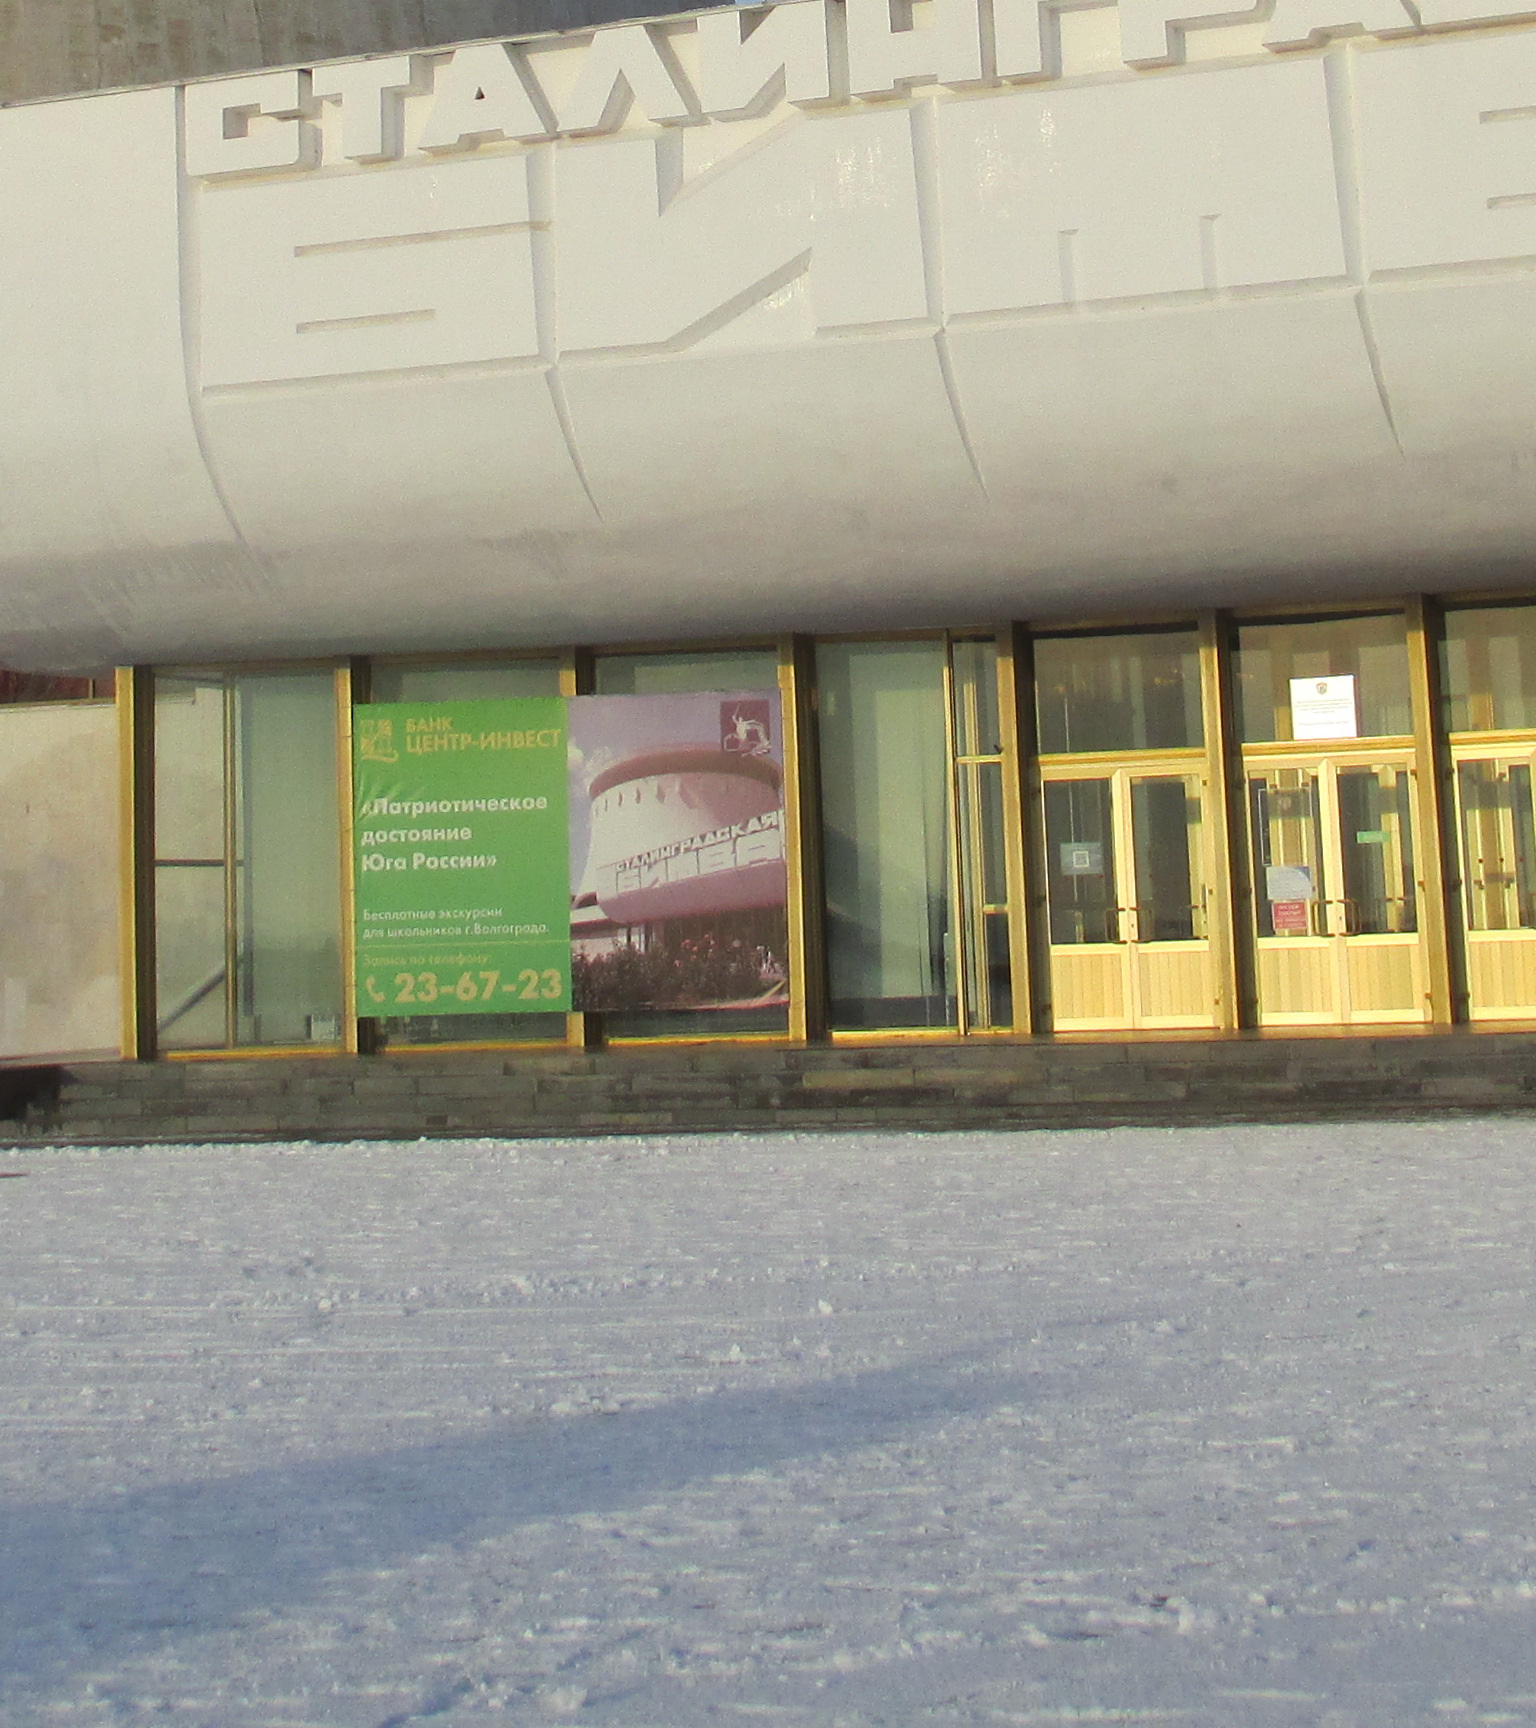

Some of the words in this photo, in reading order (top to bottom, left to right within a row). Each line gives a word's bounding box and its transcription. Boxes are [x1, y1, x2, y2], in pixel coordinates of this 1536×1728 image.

[405, 718, 453, 734] БАНК
[406, 729, 562, 754] ЦЕНТР-ИНВЕСТ
[362, 796, 548, 819] «Патриотическое
[361, 827, 473, 847] достояние
[362, 854, 407, 873] Юга
[413, 853, 498, 871] России»
[364, 909, 436, 921] Бесплатные
[439, 907, 503, 921] экскурсии
[363, 928, 384, 940] для
[388, 926, 462, 938] школьников
[394, 968, 562, 1003] 23-67-23
